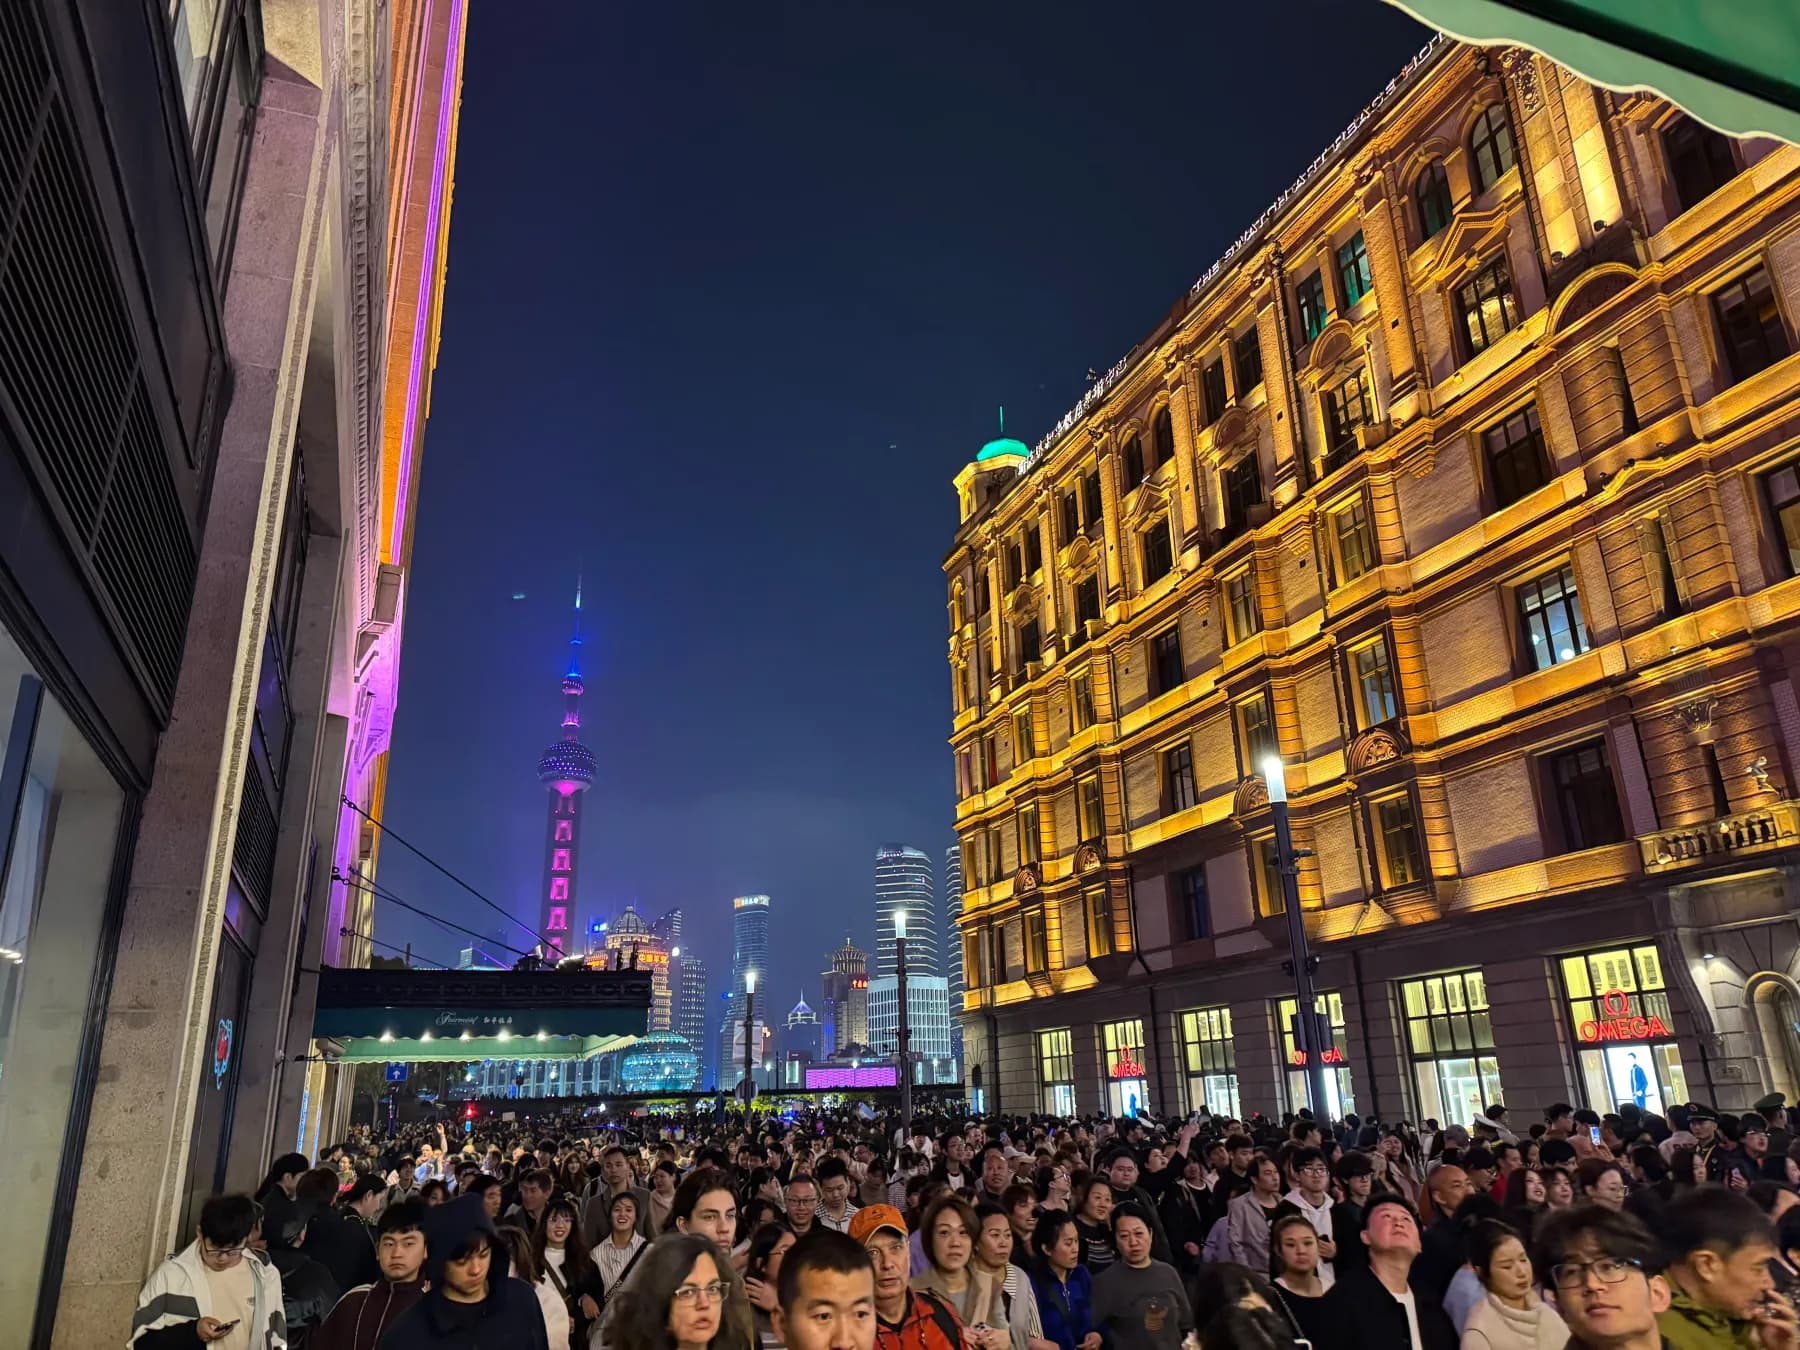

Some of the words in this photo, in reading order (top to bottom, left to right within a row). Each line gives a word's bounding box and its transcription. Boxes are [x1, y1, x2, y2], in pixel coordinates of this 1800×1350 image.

[1192, 260, 1220, 292] THE
[1223, 188, 1288, 260] SWATCH
[1292, 148, 1328, 193] ART
[1334, 78, 1396, 152] PEACE
[1402, 31, 1443, 81] HOT
[1580, 1014, 1669, 1043] OMEGA
[1293, 1046, 1343, 1066] OGA
[1111, 1062, 1146, 1078] OMEGA
